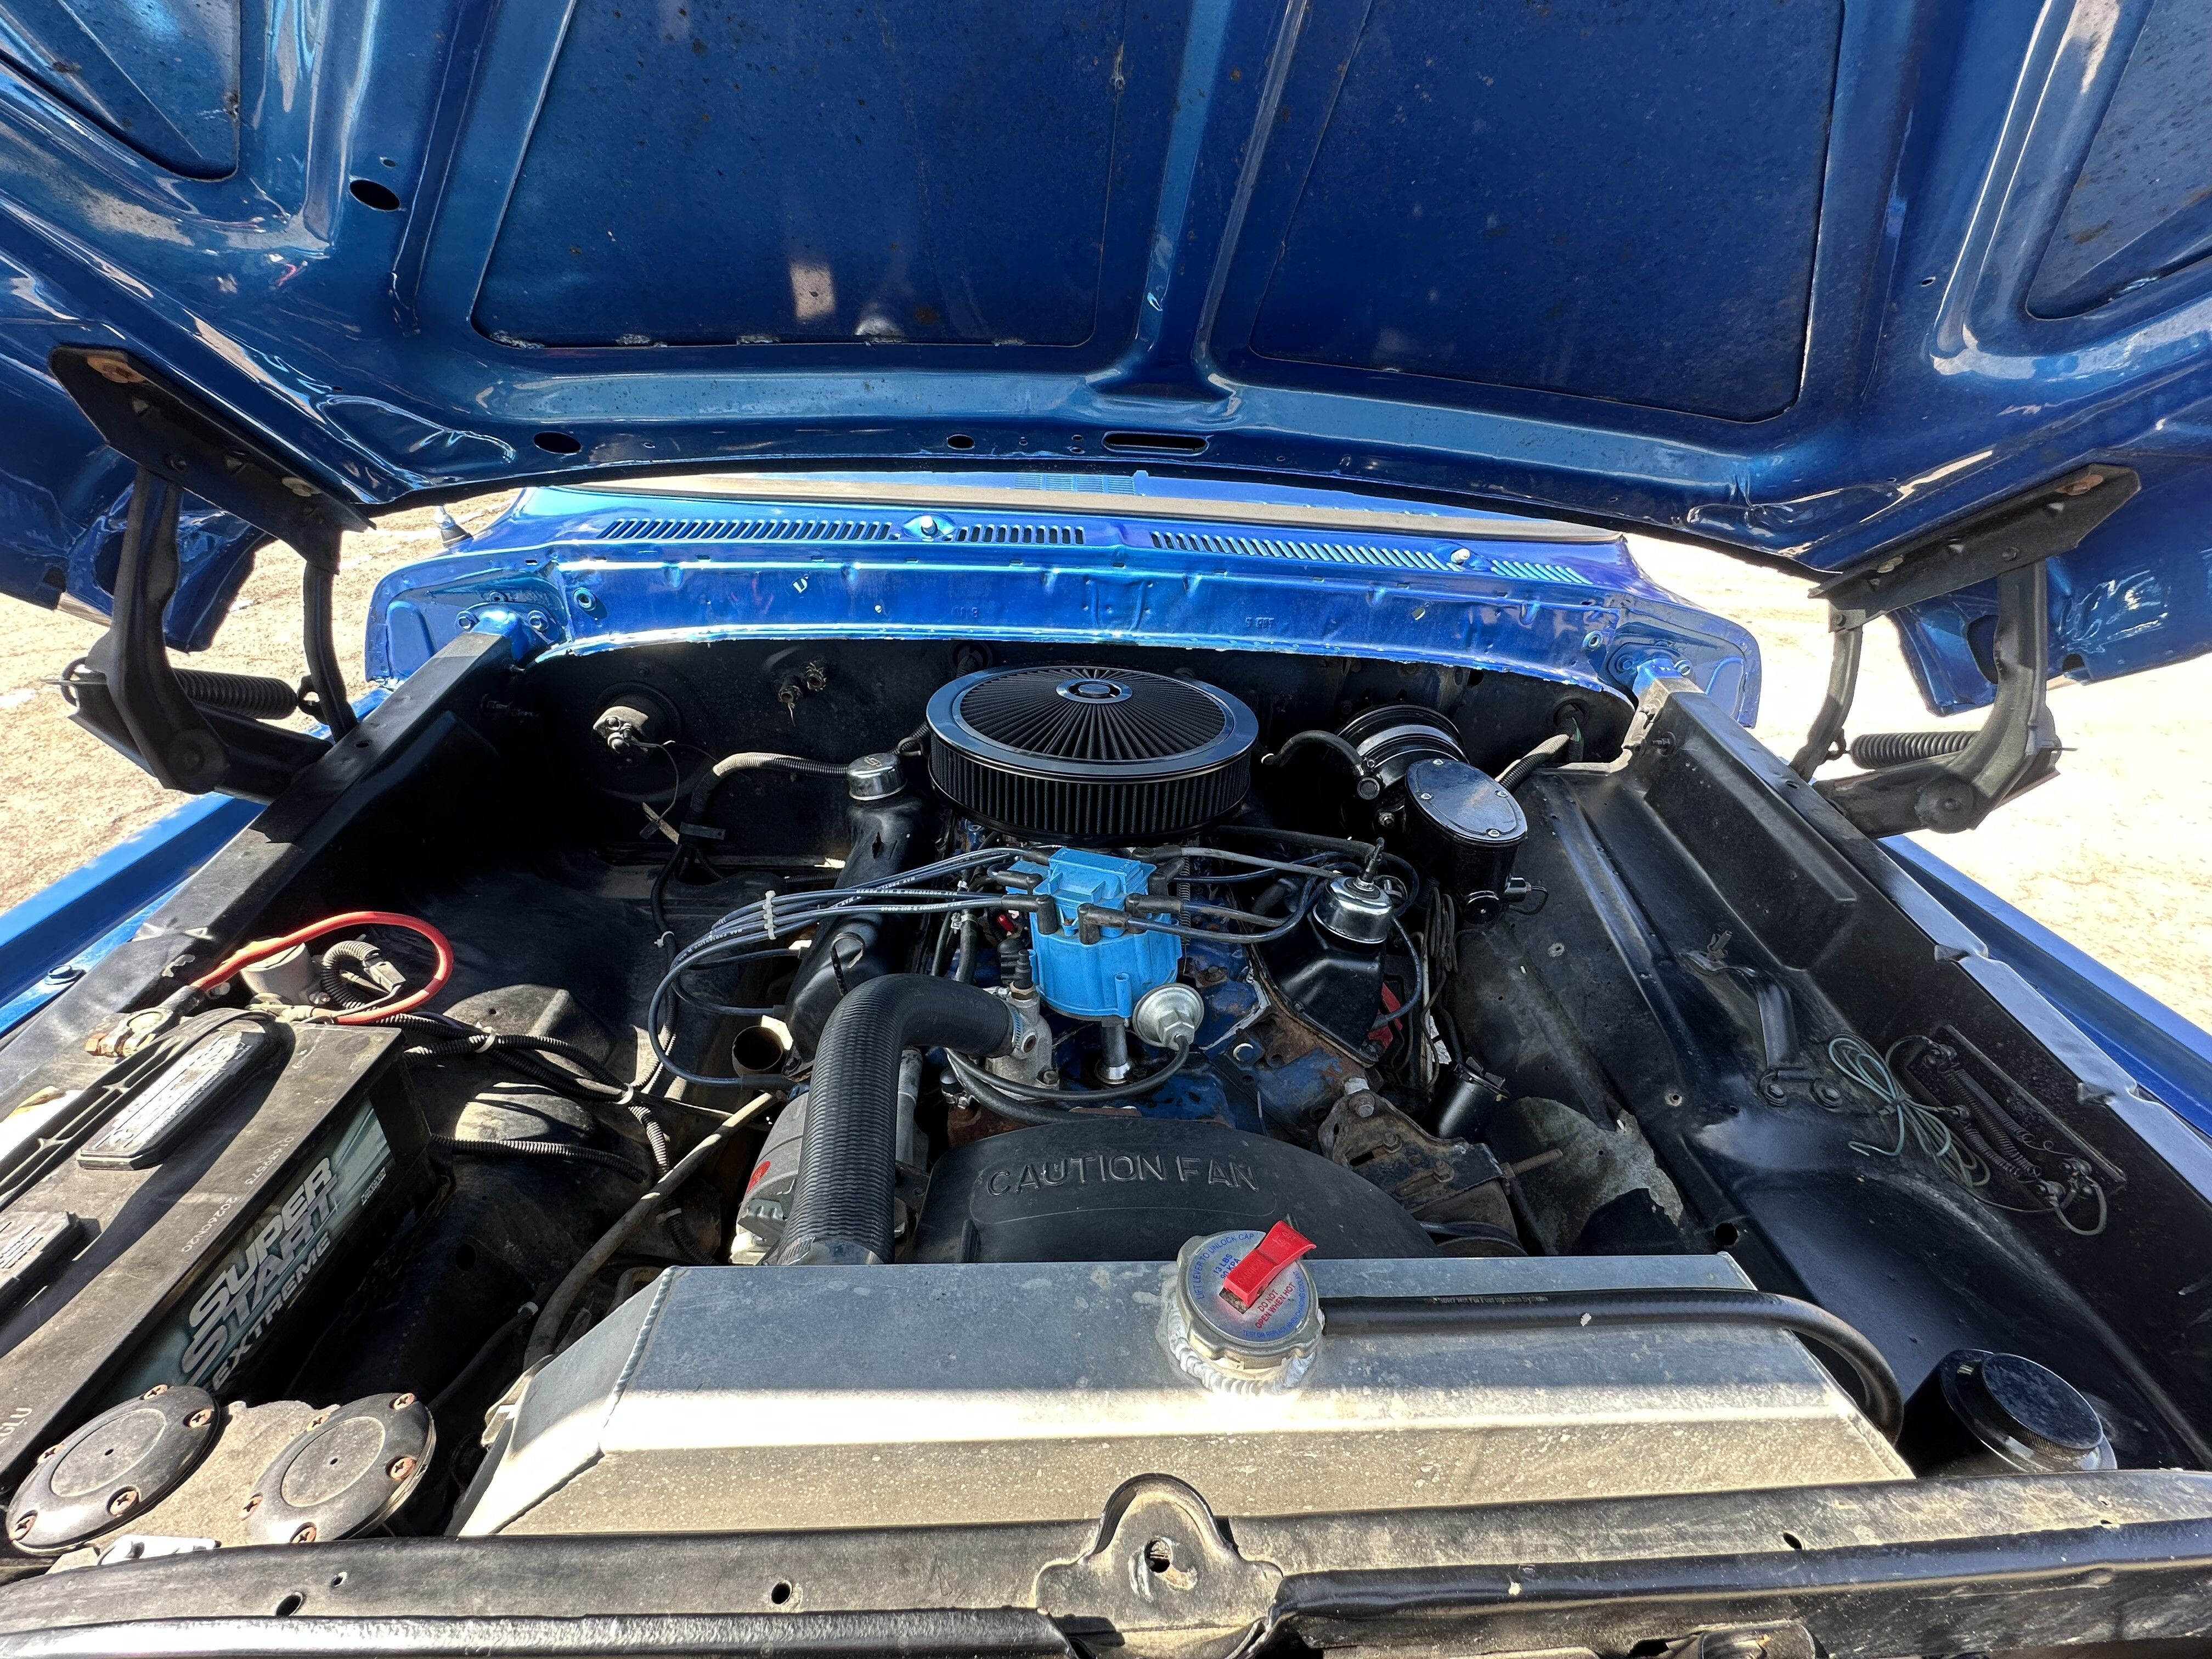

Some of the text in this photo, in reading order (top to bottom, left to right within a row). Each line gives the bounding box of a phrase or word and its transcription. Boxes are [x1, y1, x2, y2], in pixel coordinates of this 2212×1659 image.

[988, 1154, 1259, 1197] CAUTION FAN
[189, 1157, 332, 1328] SUPER
[1207, 1237, 1237, 1254] UNLOCK
[1199, 1252, 1210, 1262] TO
[1221, 1253, 1233, 1266] LBS
[182, 1174, 338, 1373] START
[1193, 1261, 1203, 1283] LEVER
[1193, 1285, 1205, 1300] LIFT
[1257, 1289, 1278, 1312] DO NOT
[212, 1231, 330, 1391] EXTREME
[1255, 1282, 1295, 1328] OPEN WHEN HOT
